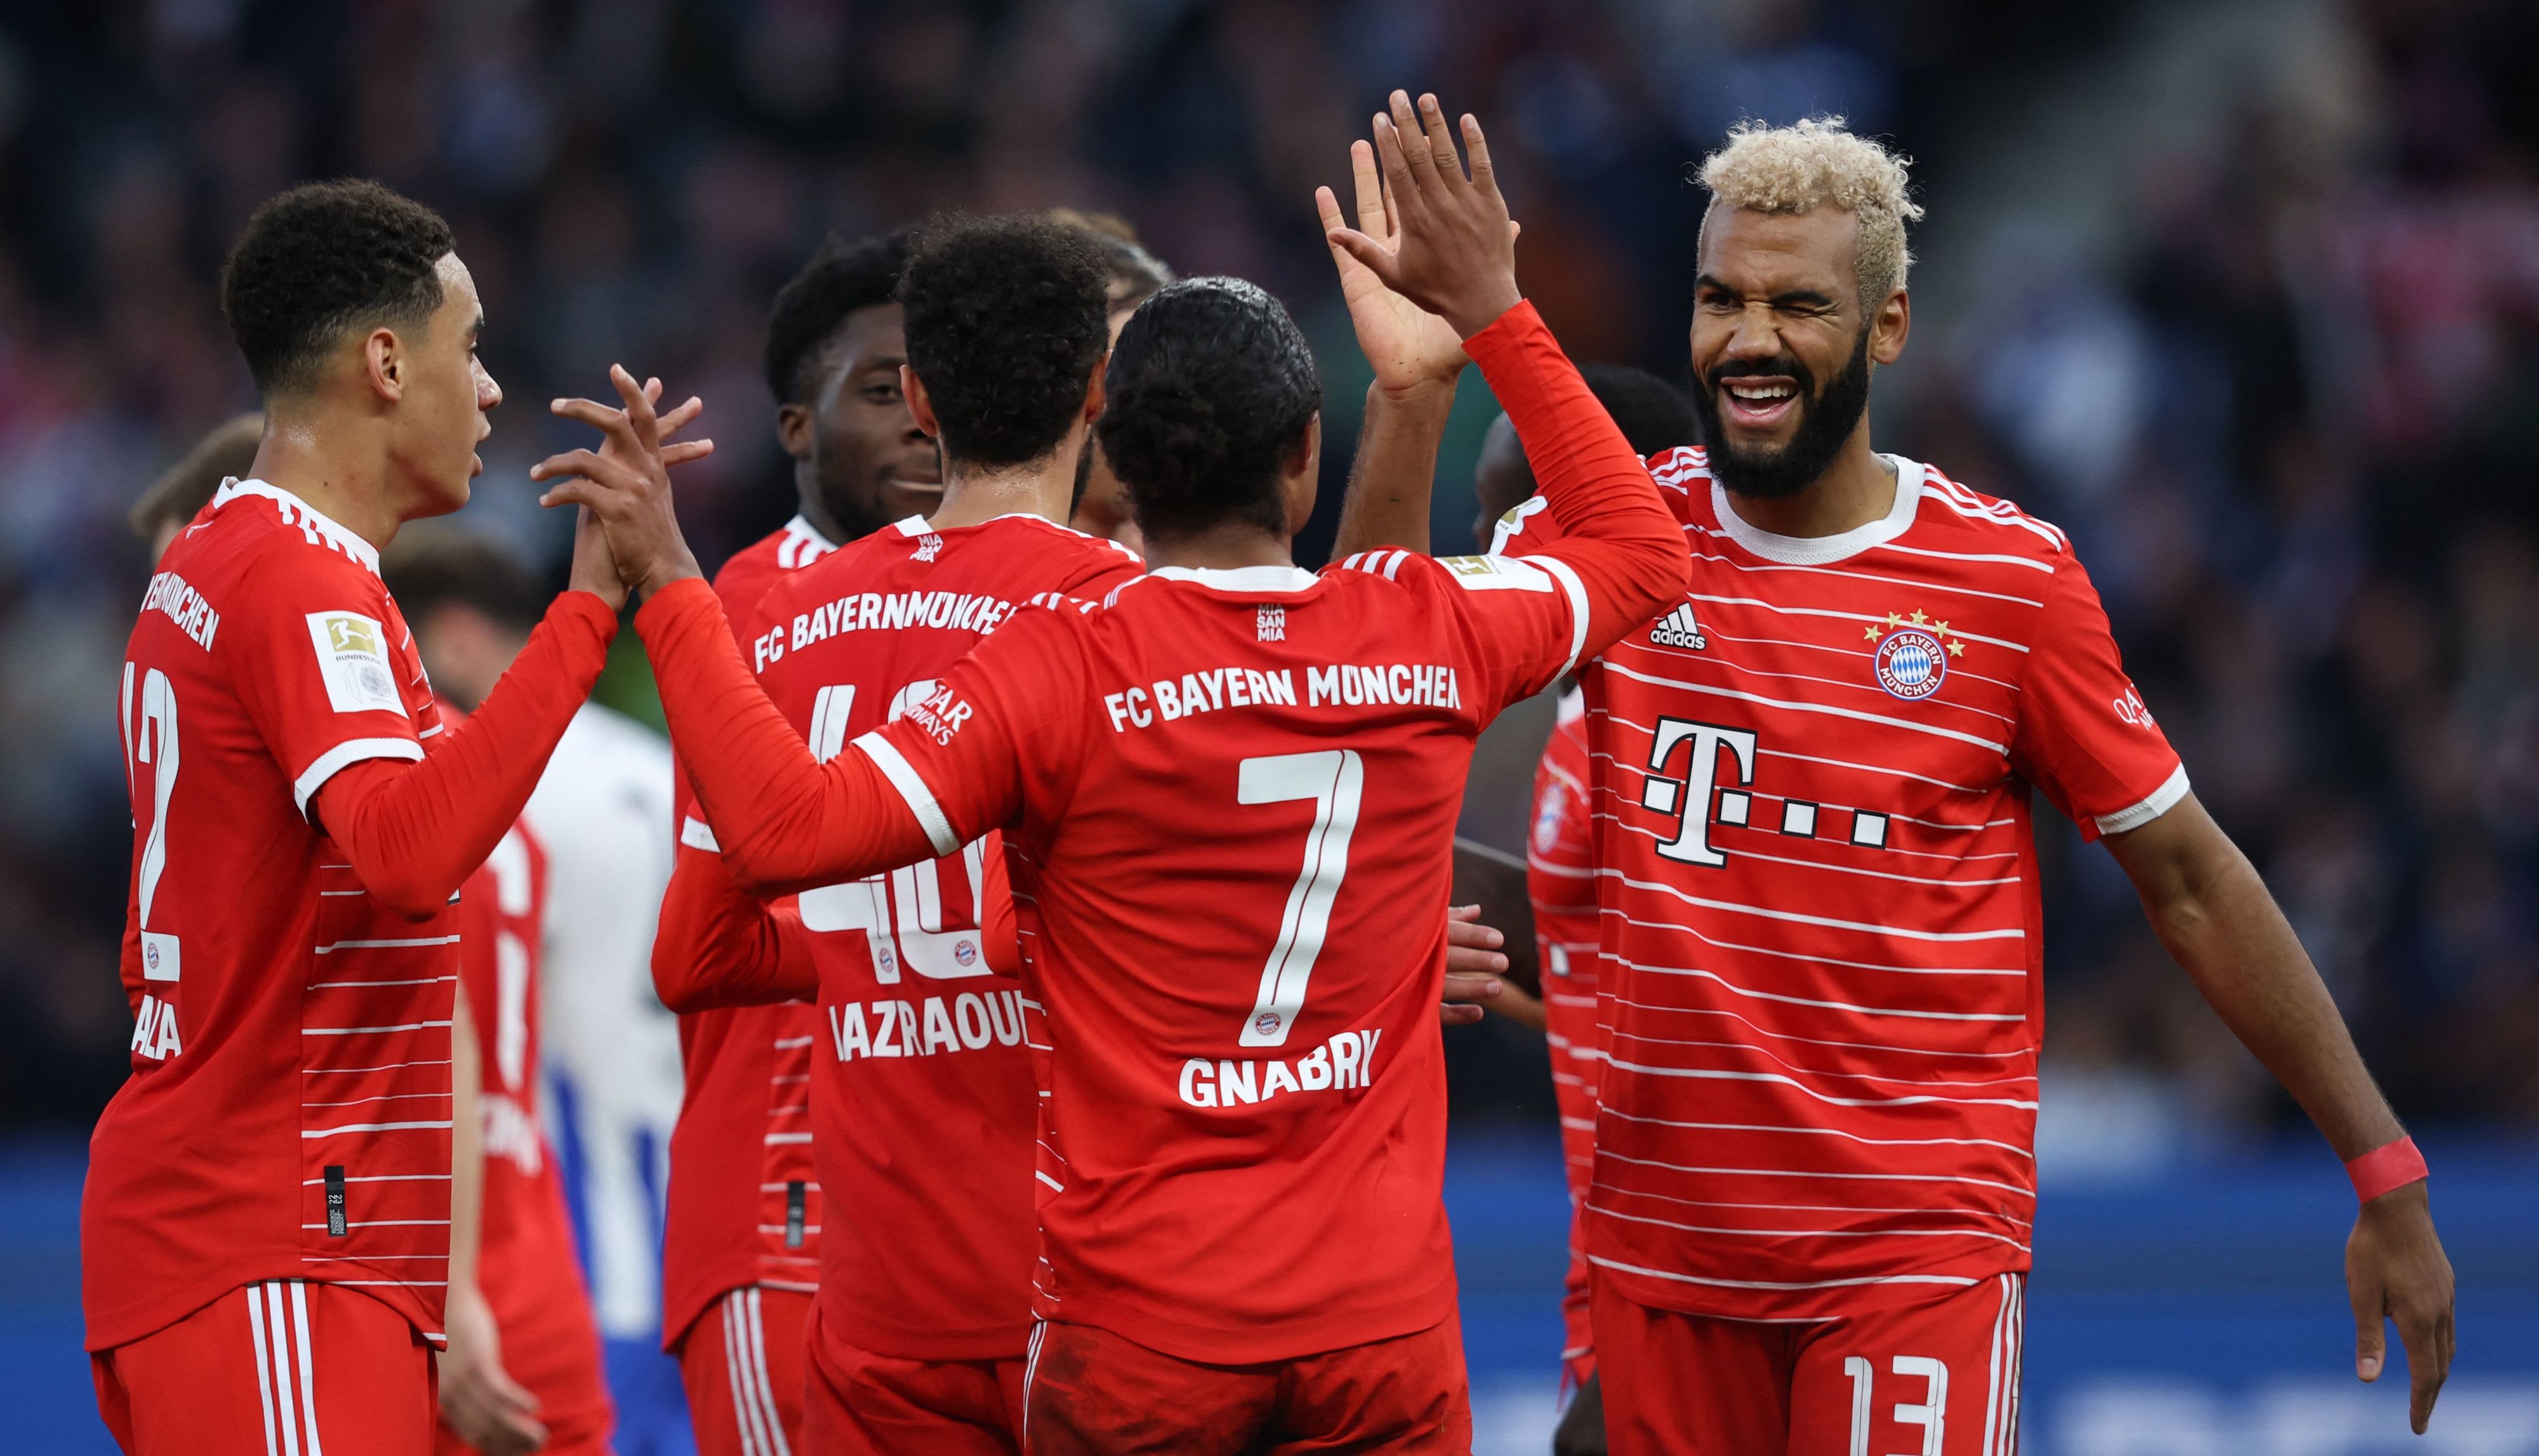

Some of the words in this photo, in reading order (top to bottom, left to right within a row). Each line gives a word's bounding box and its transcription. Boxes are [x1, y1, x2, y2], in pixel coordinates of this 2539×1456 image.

[917, 534, 943, 546] MIA
[909, 552, 934, 563] MIA
[1256, 614, 1285, 629] SAN
[1258, 603, 1285, 616] MIA
[754, 625, 785, 674] FC
[792, 593, 908, 652] BAYERN
[1257, 627, 1285, 642] MIA
[1650, 628, 1706, 650] adidas
[1882, 641, 1898, 657] FC
[1899, 635, 1942, 665] BAYERN
[1879, 667, 1939, 696] MÜNCHEN
[1104, 688, 1152, 732] FC
[1152, 668, 1297, 722] BAYERN
[1306, 664, 1462, 710] MÜNCHEN
[1237, 750, 1364, 1047] 7
[1178, 1028, 1382, 1108] GNABRY
[1844, 1355, 1949, 1456] 13
